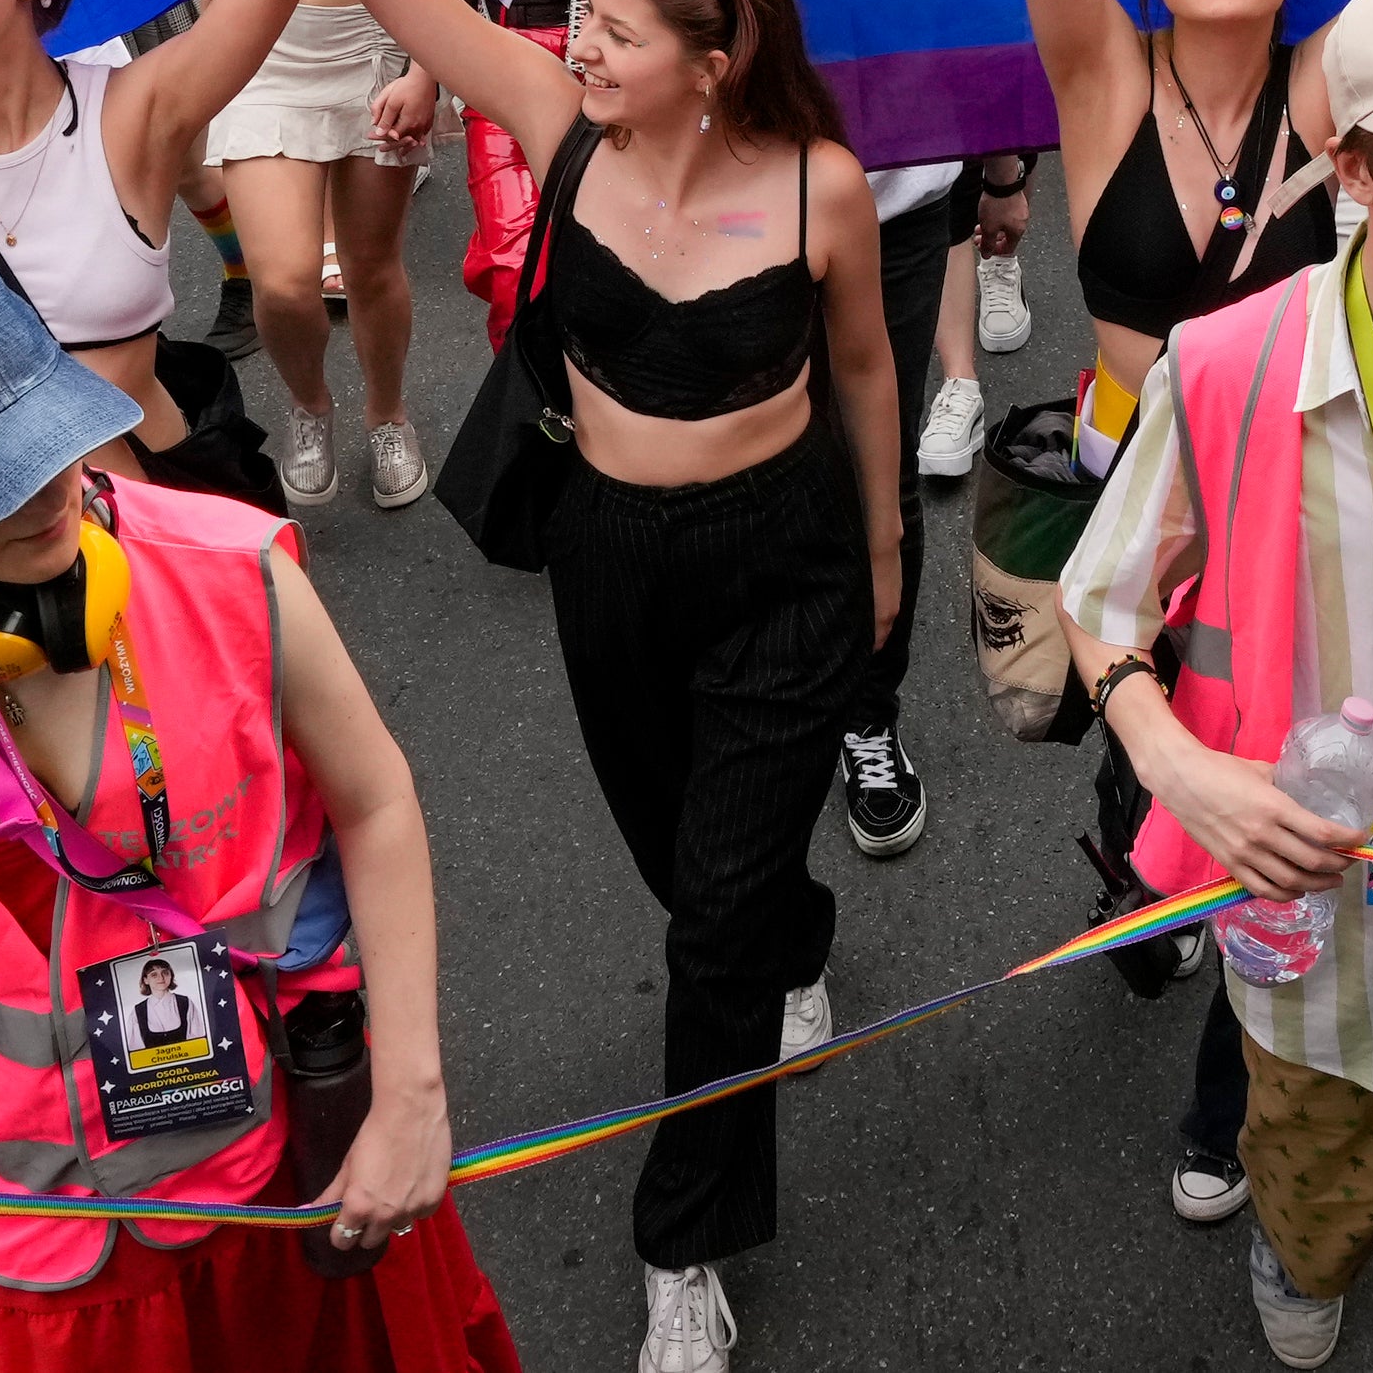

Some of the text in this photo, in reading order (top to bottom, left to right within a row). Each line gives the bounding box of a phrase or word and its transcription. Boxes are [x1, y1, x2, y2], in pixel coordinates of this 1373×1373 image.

[97, 774, 254, 855] TĘZOWY
[155, 1045, 182, 1056] Jagna
[129, 1069, 219, 1093] KOORDYNATORSKA
[156, 1067, 190, 1079] OSOBA
[116, 1093, 163, 1110] PARADA
[162, 1079, 244, 1105] RÓWNOŚCI
